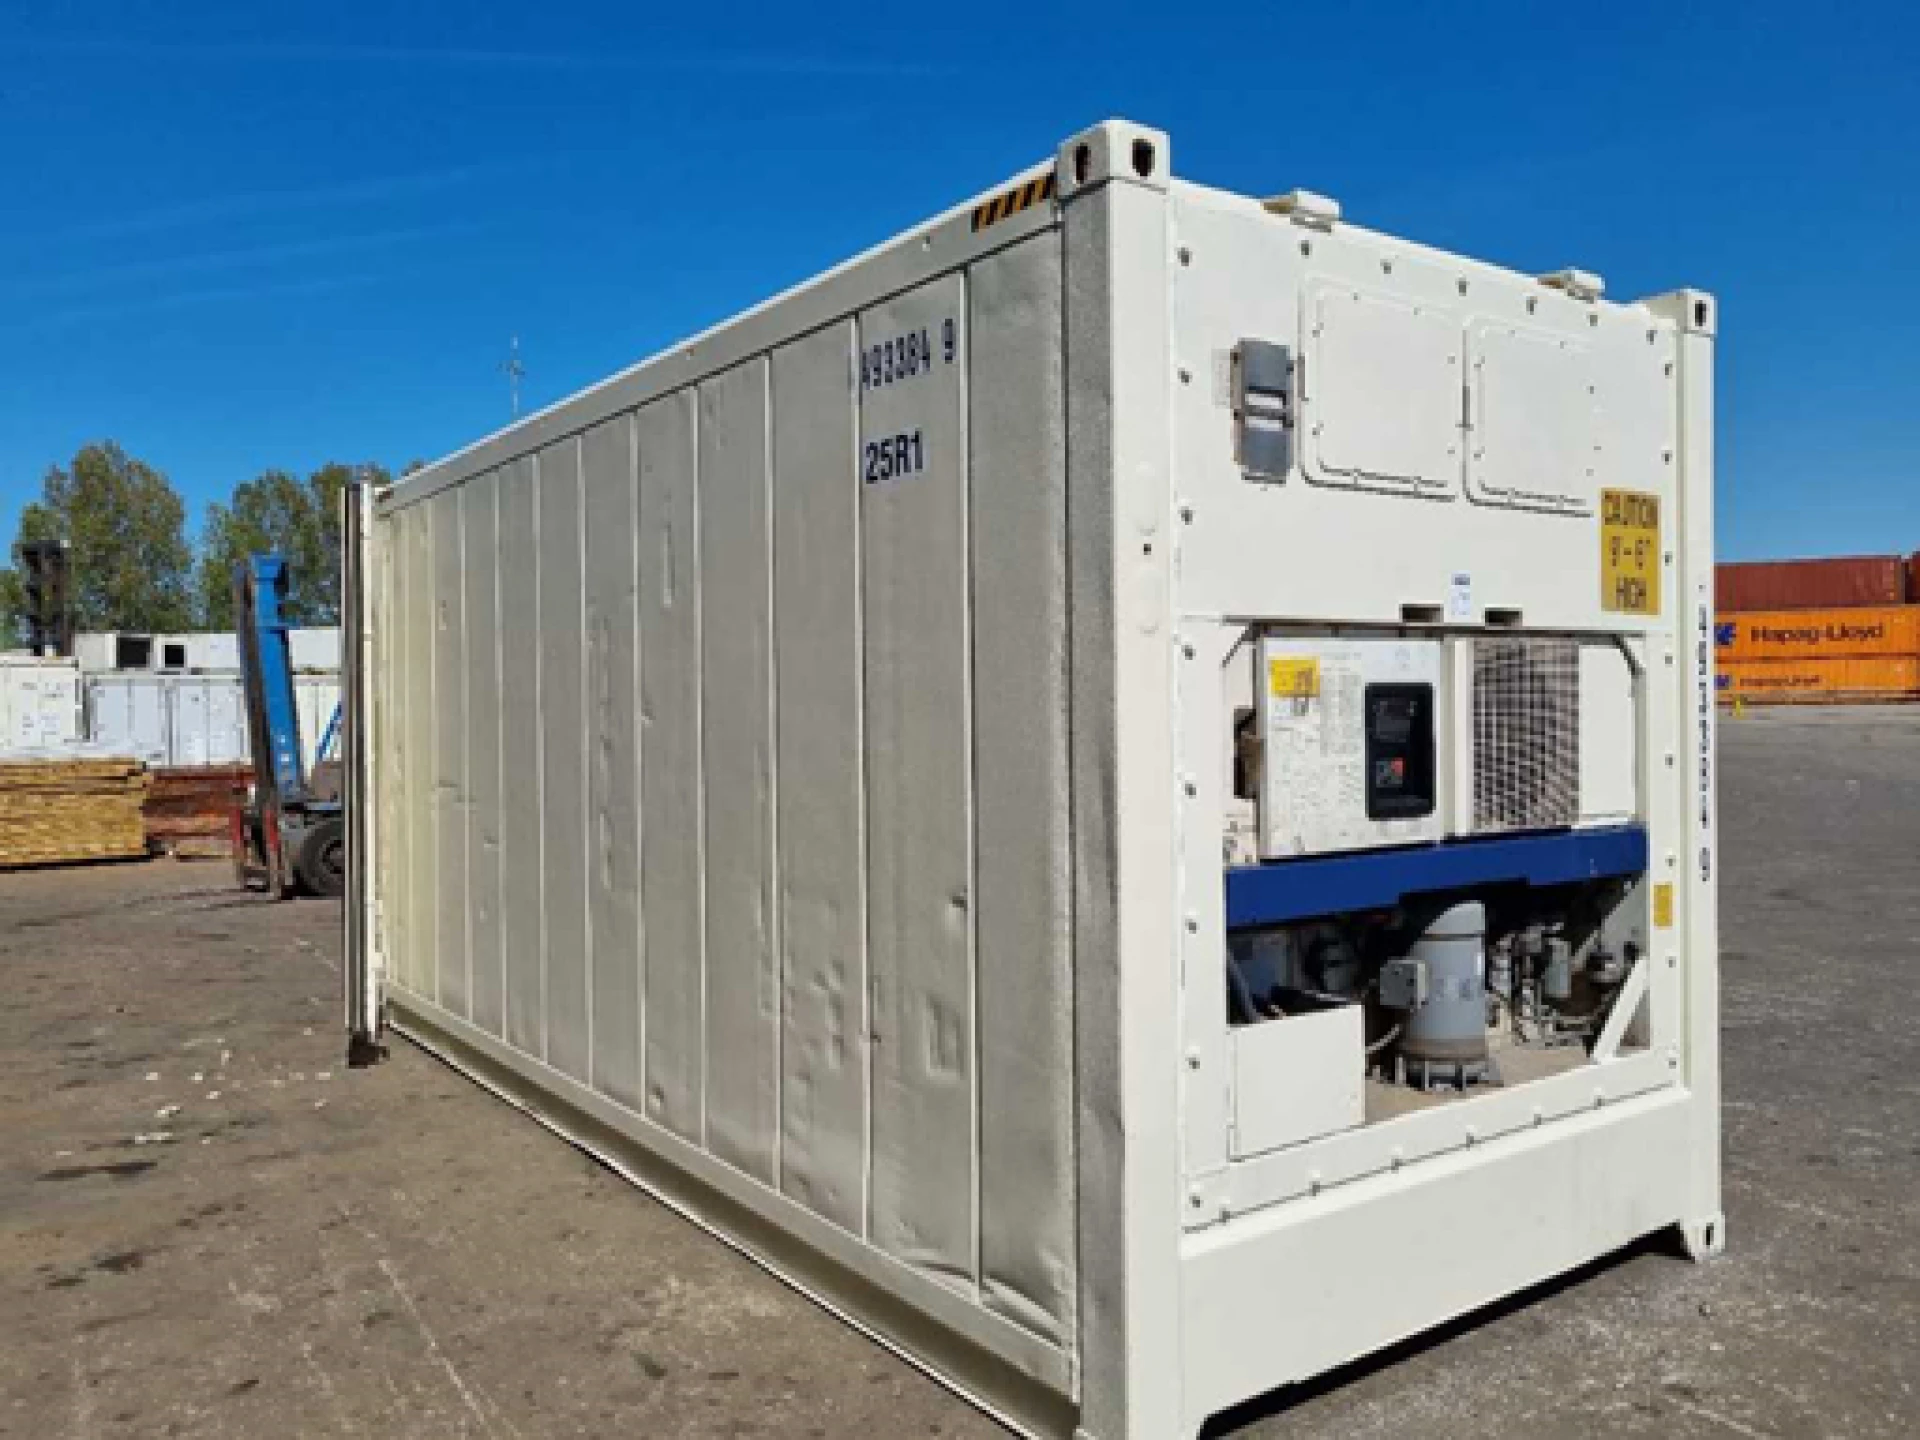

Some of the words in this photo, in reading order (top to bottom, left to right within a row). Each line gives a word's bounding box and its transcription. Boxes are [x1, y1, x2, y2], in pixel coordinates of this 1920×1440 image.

[942, 317, 956, 364] 9
[865, 429, 924, 485] 25R1
[1750, 622, 1884, 646] Hapag-Lloyd
